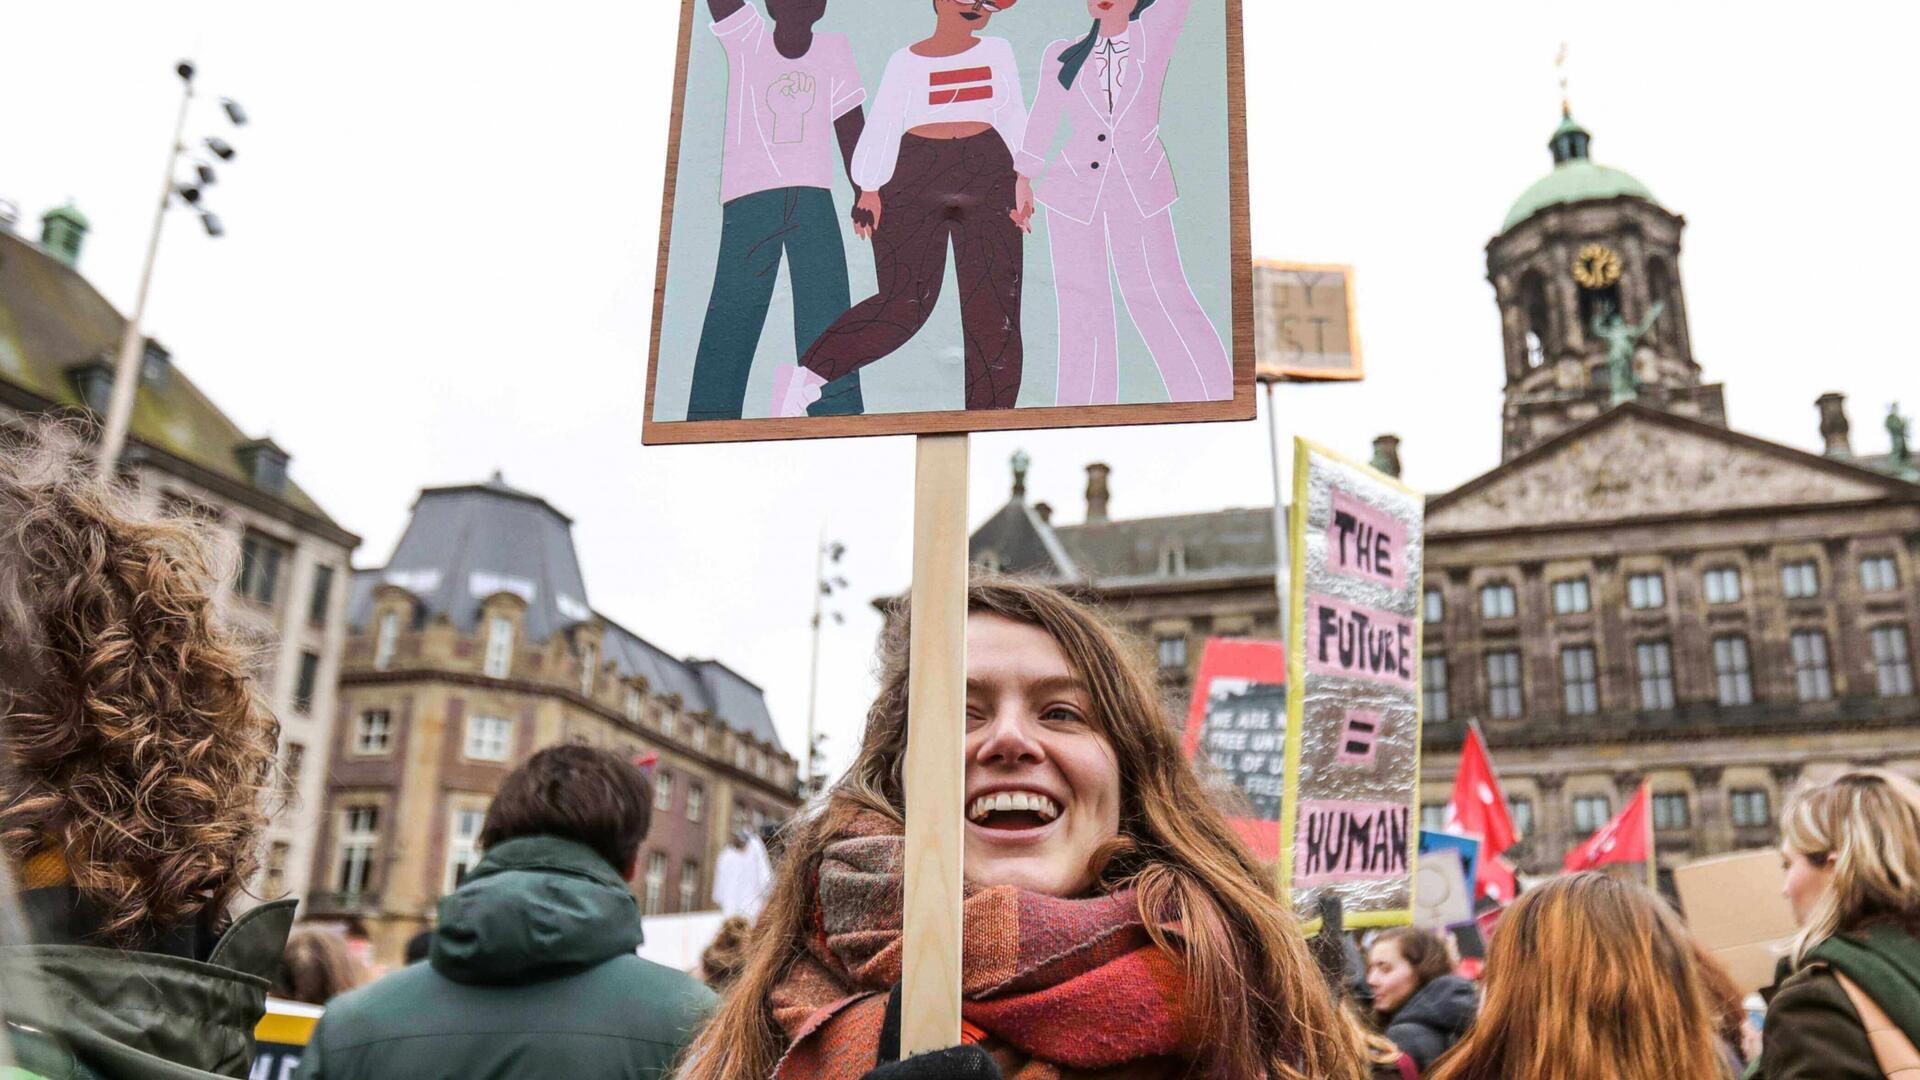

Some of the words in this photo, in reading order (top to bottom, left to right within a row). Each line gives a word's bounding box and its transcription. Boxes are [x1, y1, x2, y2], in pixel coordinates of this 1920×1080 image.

[1334, 509, 1393, 577] THE
[1318, 605, 1411, 680] FUTURE
[1209, 730, 1249, 751] FREE
[1210, 710, 1234, 729] WE
[1237, 710, 1271, 730] ARE
[1239, 752, 1266, 773] OF
[1305, 807, 1409, 876] HUMAN
